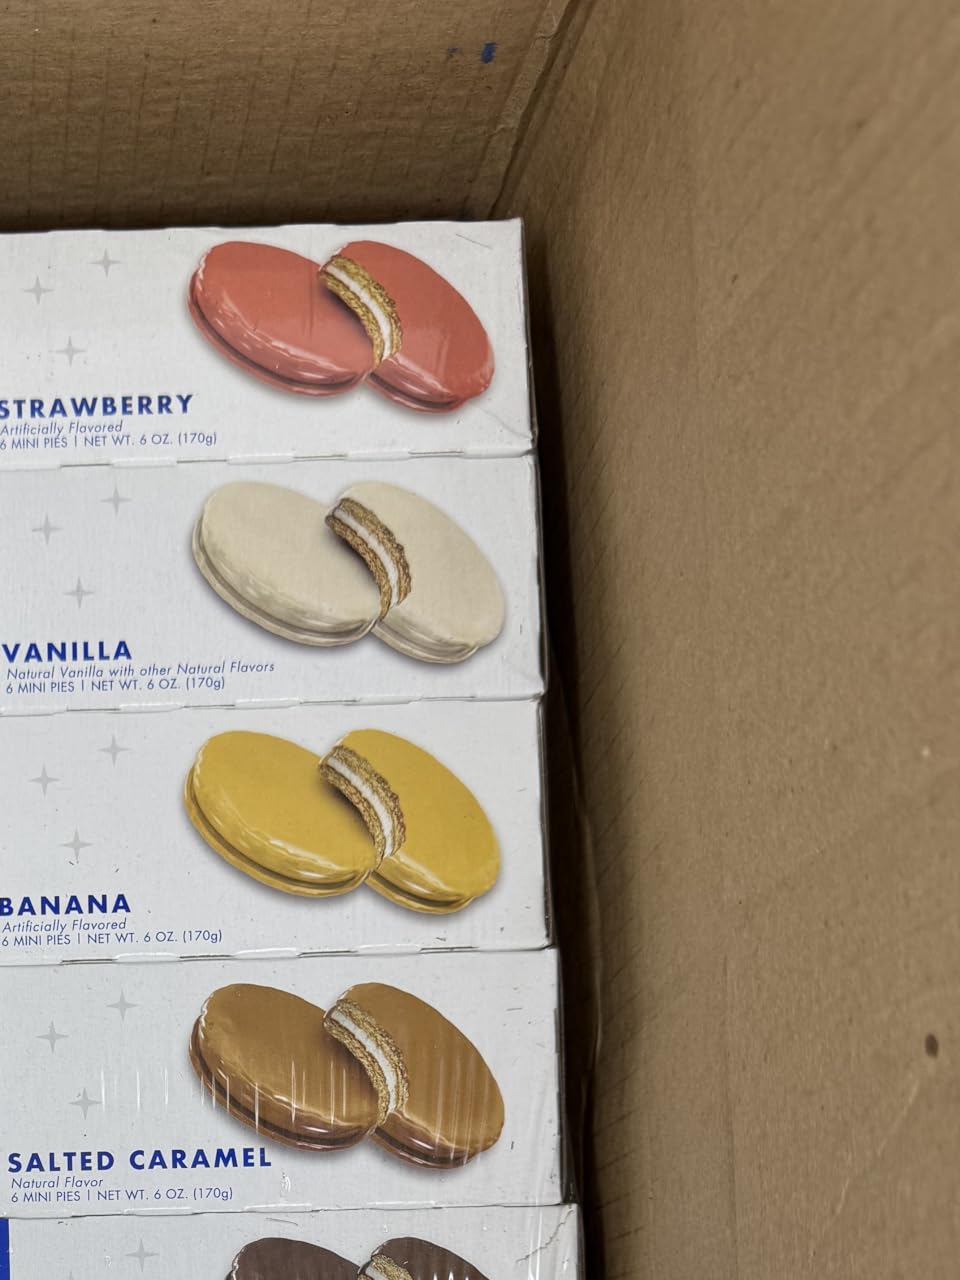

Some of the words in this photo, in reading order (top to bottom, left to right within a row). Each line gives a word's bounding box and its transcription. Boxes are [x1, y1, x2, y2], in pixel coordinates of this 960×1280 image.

[0, 421, 64, 436] Artificially
[69, 420, 123, 433] Flavored
[0, 439, 6, 450] 6
[12, 437, 38, 449] MINI
[44, 438, 68, 448] PIES
[84, 436, 107, 447] NET
[112, 435, 135, 447] WT.
[140, 434, 147, 445] 6
[152, 434, 172, 445] OZ.
[178, 432, 217, 446] (170g)
[2, 640, 132, 663] VANILLA
[7, 666, 55, 680] Natural
[60, 665, 103, 678] Vanilla
[110, 664, 134, 677] with
[140, 665, 171, 676] other
[177, 662, 225, 675] Natural
[230, 661, 275, 673] Flavors
[6, 682, 13, 694] 6
[18, 682, 46, 693] MINI
[51, 681, 74, 692] PIES
[92, 680, 114, 691] NET
[119, 679, 142, 690] WT.
[147, 678, 154, 689] 6
[159, 678, 181, 689] OZ.
[187, 676, 225, 690] (170g)
[0, 894, 131, 916] BANANA
[2, 919, 67, 934] Artificially
[72, 918, 126, 931] Flavored
[2, 936, 9, 947] 6
[14, 935, 42, 946] MINI
[47, 934, 71, 945] PIES
[88, 933, 110, 944] NET
[115, 932, 138, 943] WT.
[144, 932, 151, 942] 6
[156, 931, 178, 942] OZ.
[183, 930, 222, 943] (170g)
[8, 1151, 114, 1173] SALTED
[129, 1148, 272, 1170] CARAMEL
[12, 1176, 60, 1189] Natural
[64, 1176, 103, 1188] Flavor
[11, 1192, 18, 1203] 6
[23, 1191, 51, 1202] MINI
[57, 1190, 80, 1202] PIES
[98, 1190, 120, 1200] NET
[126, 1189, 149, 1200] WT.
[154, 1188, 161, 1199] 6
[166, 1188, 188, 1199] OZ.
[193, 1186, 232, 1200] (170g)
